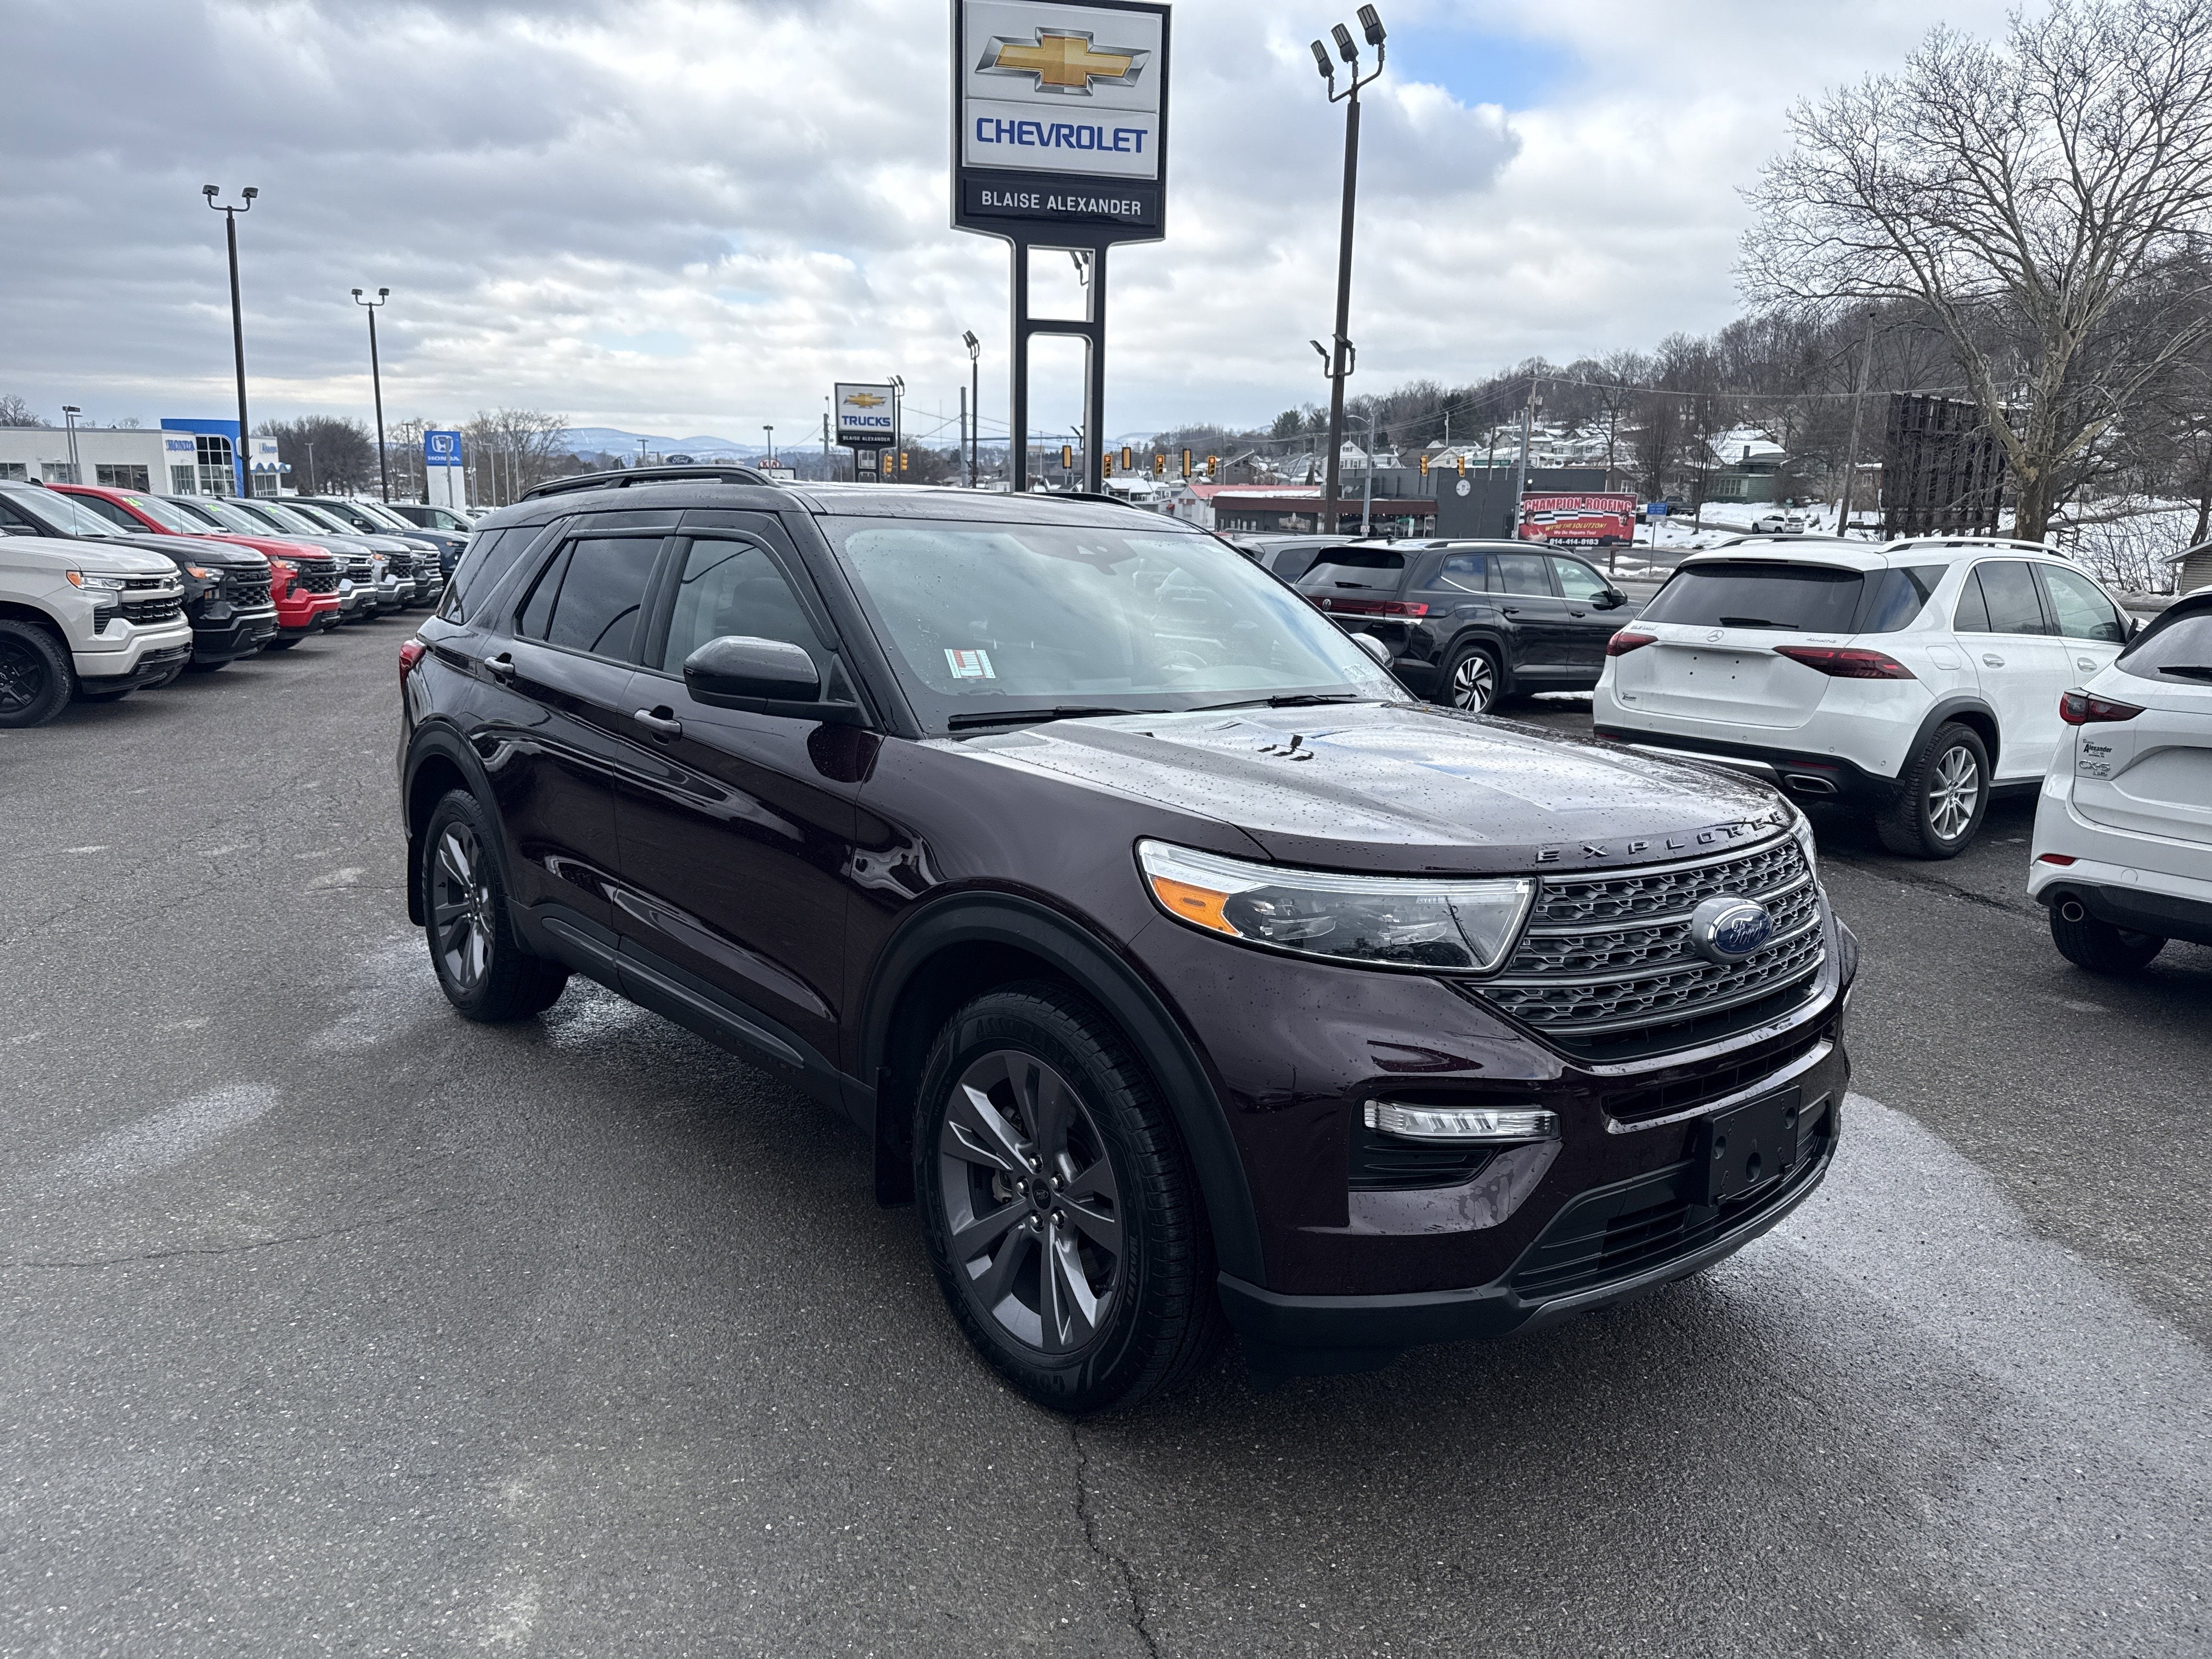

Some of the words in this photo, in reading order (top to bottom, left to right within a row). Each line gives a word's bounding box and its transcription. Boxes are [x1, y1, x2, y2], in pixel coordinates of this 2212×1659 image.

[976, 117, 1148, 154] CHEVROLET
[981, 190, 1041, 209] BLAISE
[1046, 195, 1142, 216] ALEXANDER
[842, 415, 891, 427] TRUCKS
[1523, 497, 1582, 512] CHAMPION
[1584, 497, 1632, 514] ROOFING
[2083, 744, 2113, 753] Alexander
[2079, 760, 2111, 772] CX-5
[1537, 810, 1782, 862] EXPLORER
[1729, 916, 1764, 945] Ford
